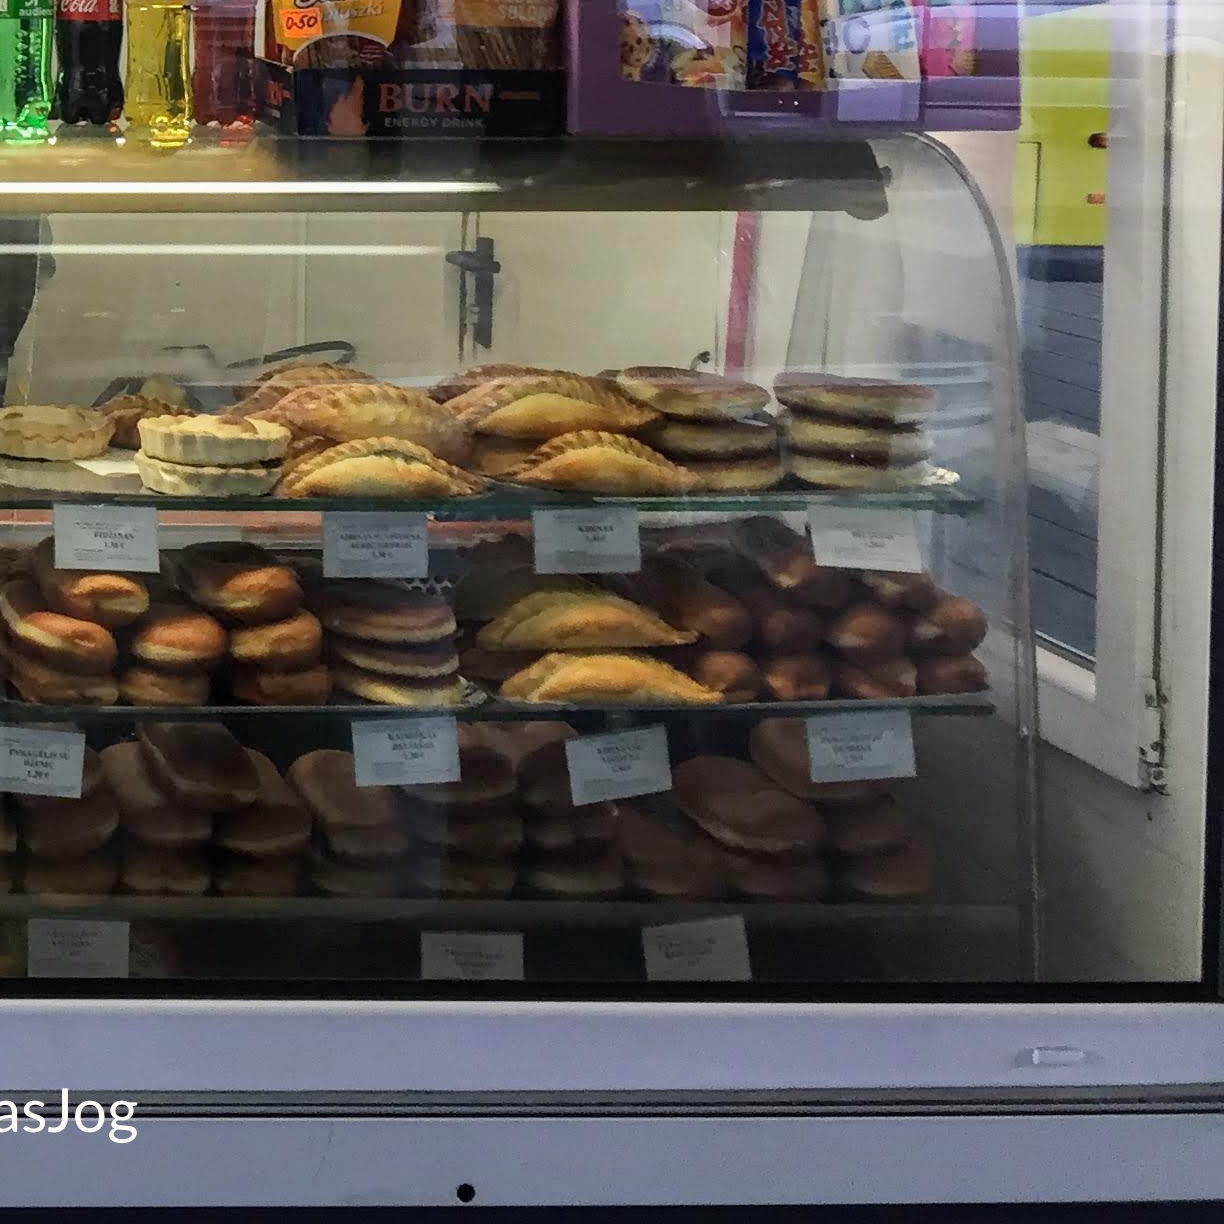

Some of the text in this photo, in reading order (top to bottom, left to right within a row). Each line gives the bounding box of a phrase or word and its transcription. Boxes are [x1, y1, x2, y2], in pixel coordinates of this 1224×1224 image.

[379, 83, 493, 113] BURN
[384, 117, 485, 129] ENERGY DRINK
